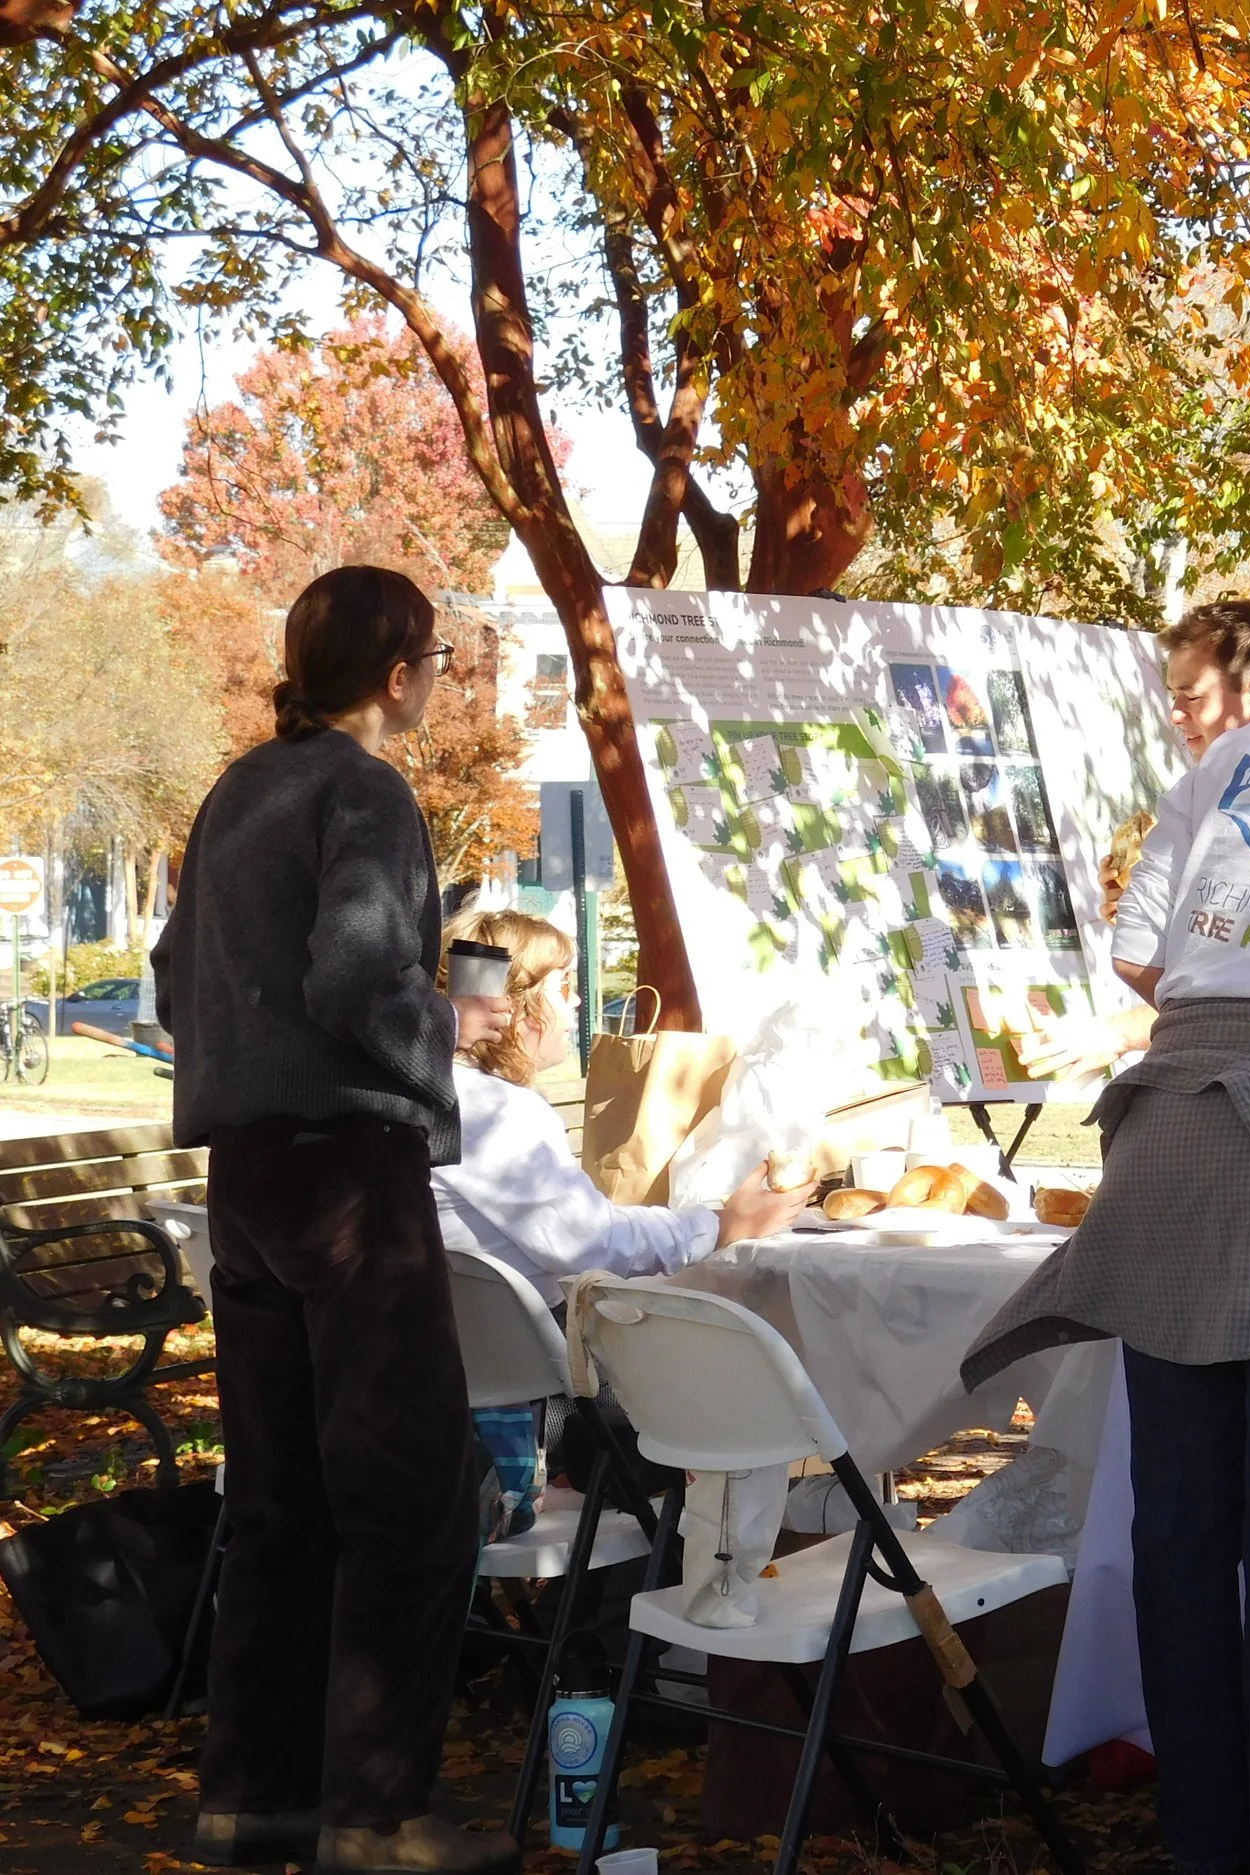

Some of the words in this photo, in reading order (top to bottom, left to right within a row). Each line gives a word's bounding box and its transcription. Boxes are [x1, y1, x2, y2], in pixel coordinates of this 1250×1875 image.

[628, 612, 678, 625] ICHMOND
[681, 615, 705, 627] TREE
[676, 633, 720, 645] connection
[764, 637, 806, 649] Richmond!
